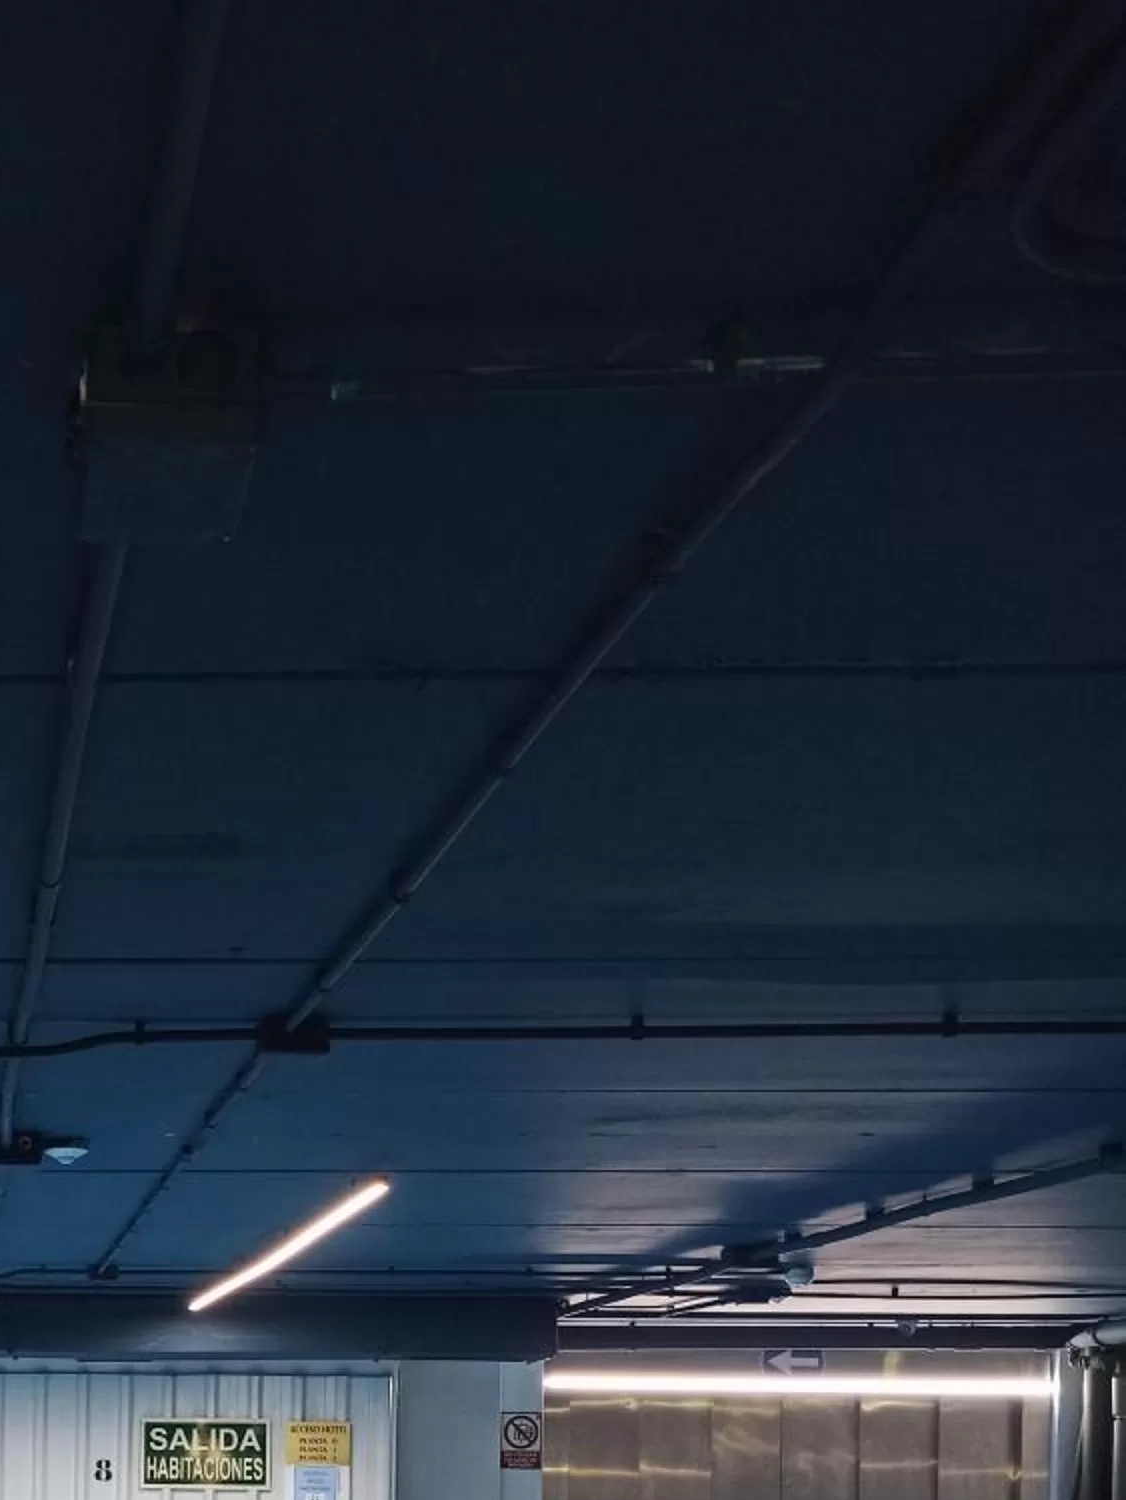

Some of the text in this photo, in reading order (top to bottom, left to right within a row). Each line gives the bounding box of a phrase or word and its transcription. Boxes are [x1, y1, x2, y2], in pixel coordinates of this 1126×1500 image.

[149, 1427, 262, 1451] SALIDA
[94, 1459, 113, 1482] 8
[147, 1456, 263, 1480] HABITACIONES
